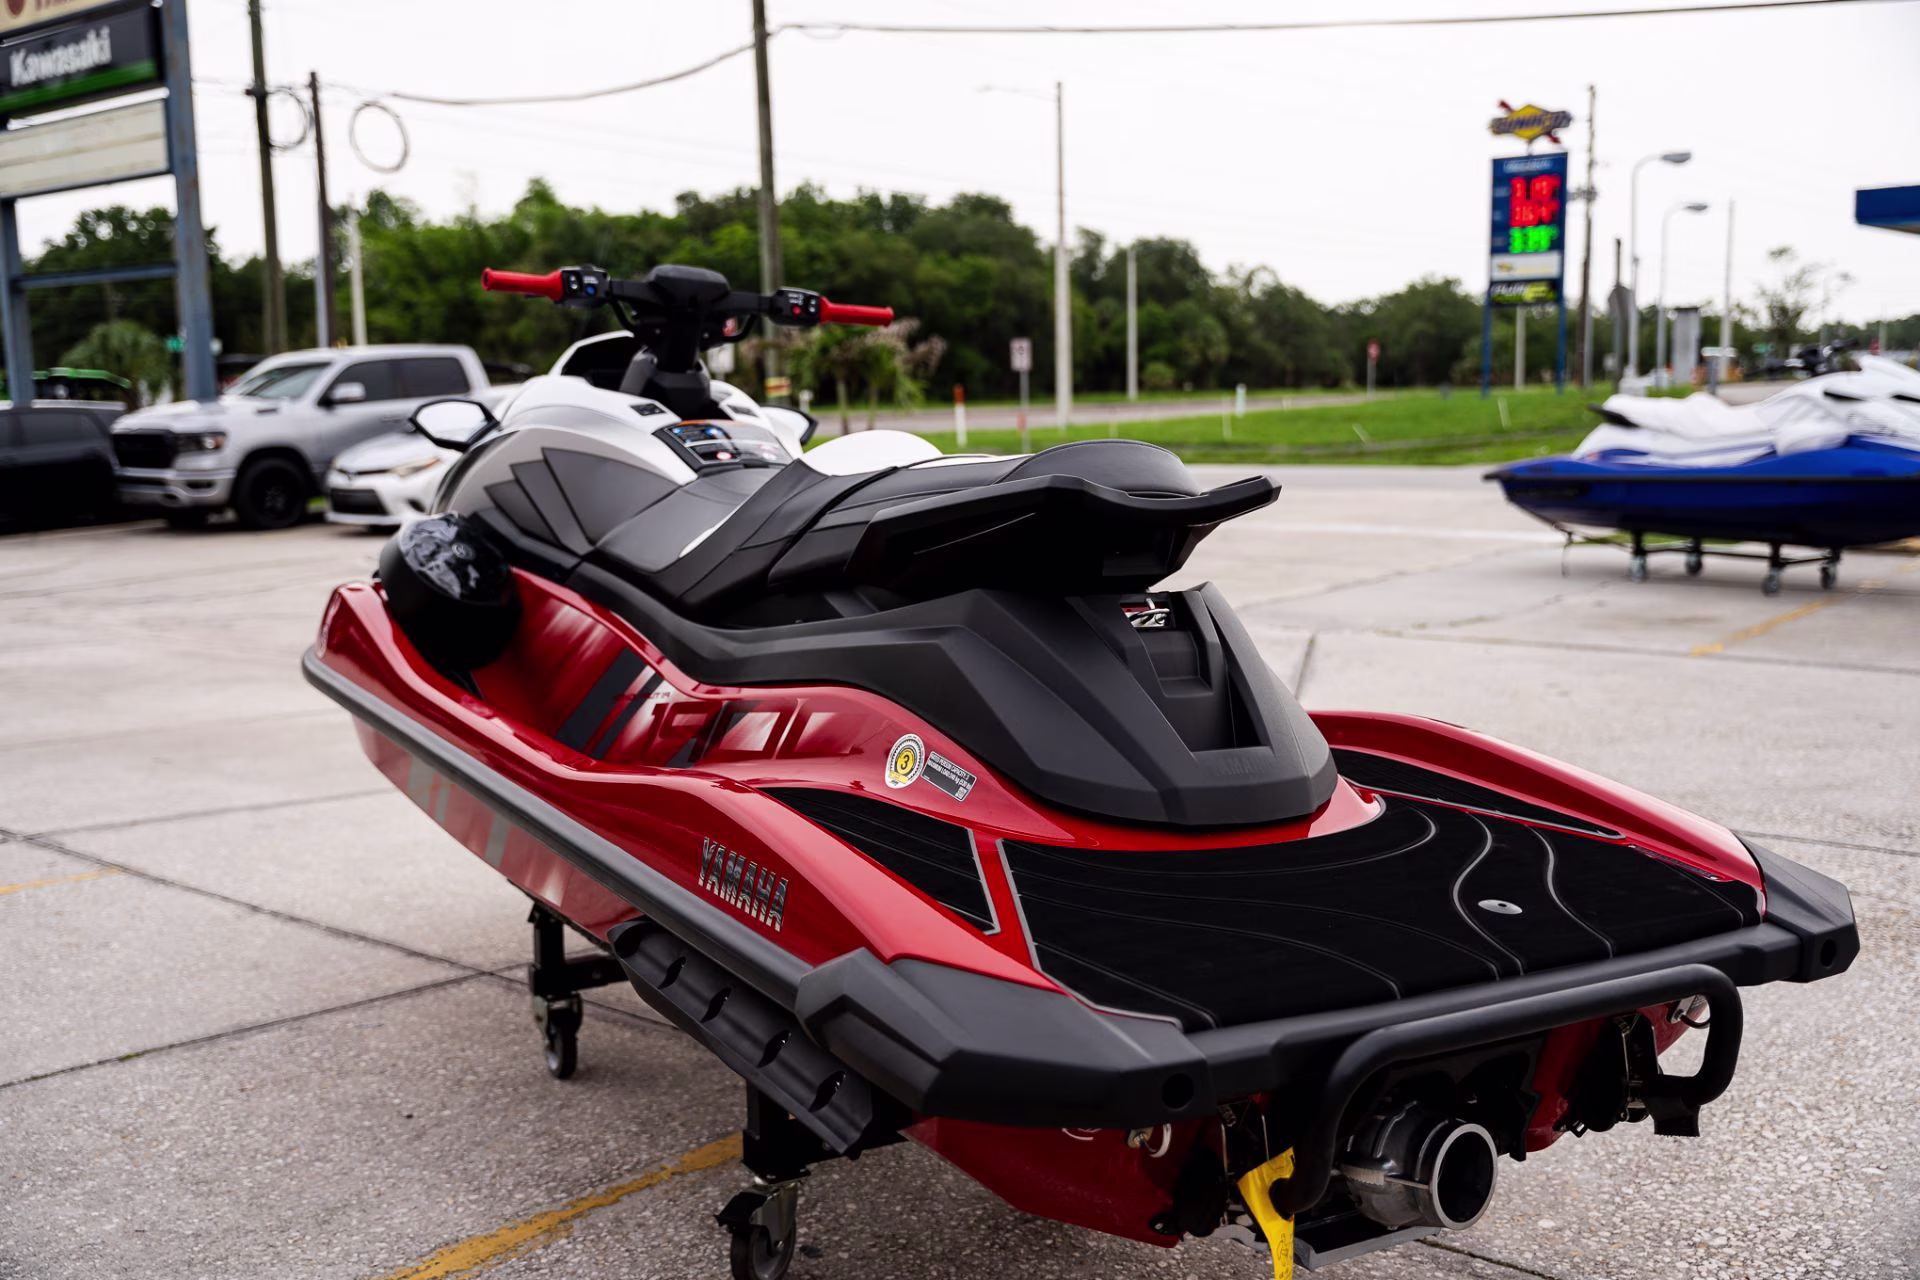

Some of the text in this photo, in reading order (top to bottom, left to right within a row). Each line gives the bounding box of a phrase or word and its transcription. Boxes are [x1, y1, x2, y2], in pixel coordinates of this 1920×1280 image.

[9, 24, 112, 88] Kawasaki
[900, 754, 910, 770] 3
[698, 836, 788, 932] YAMAHA
